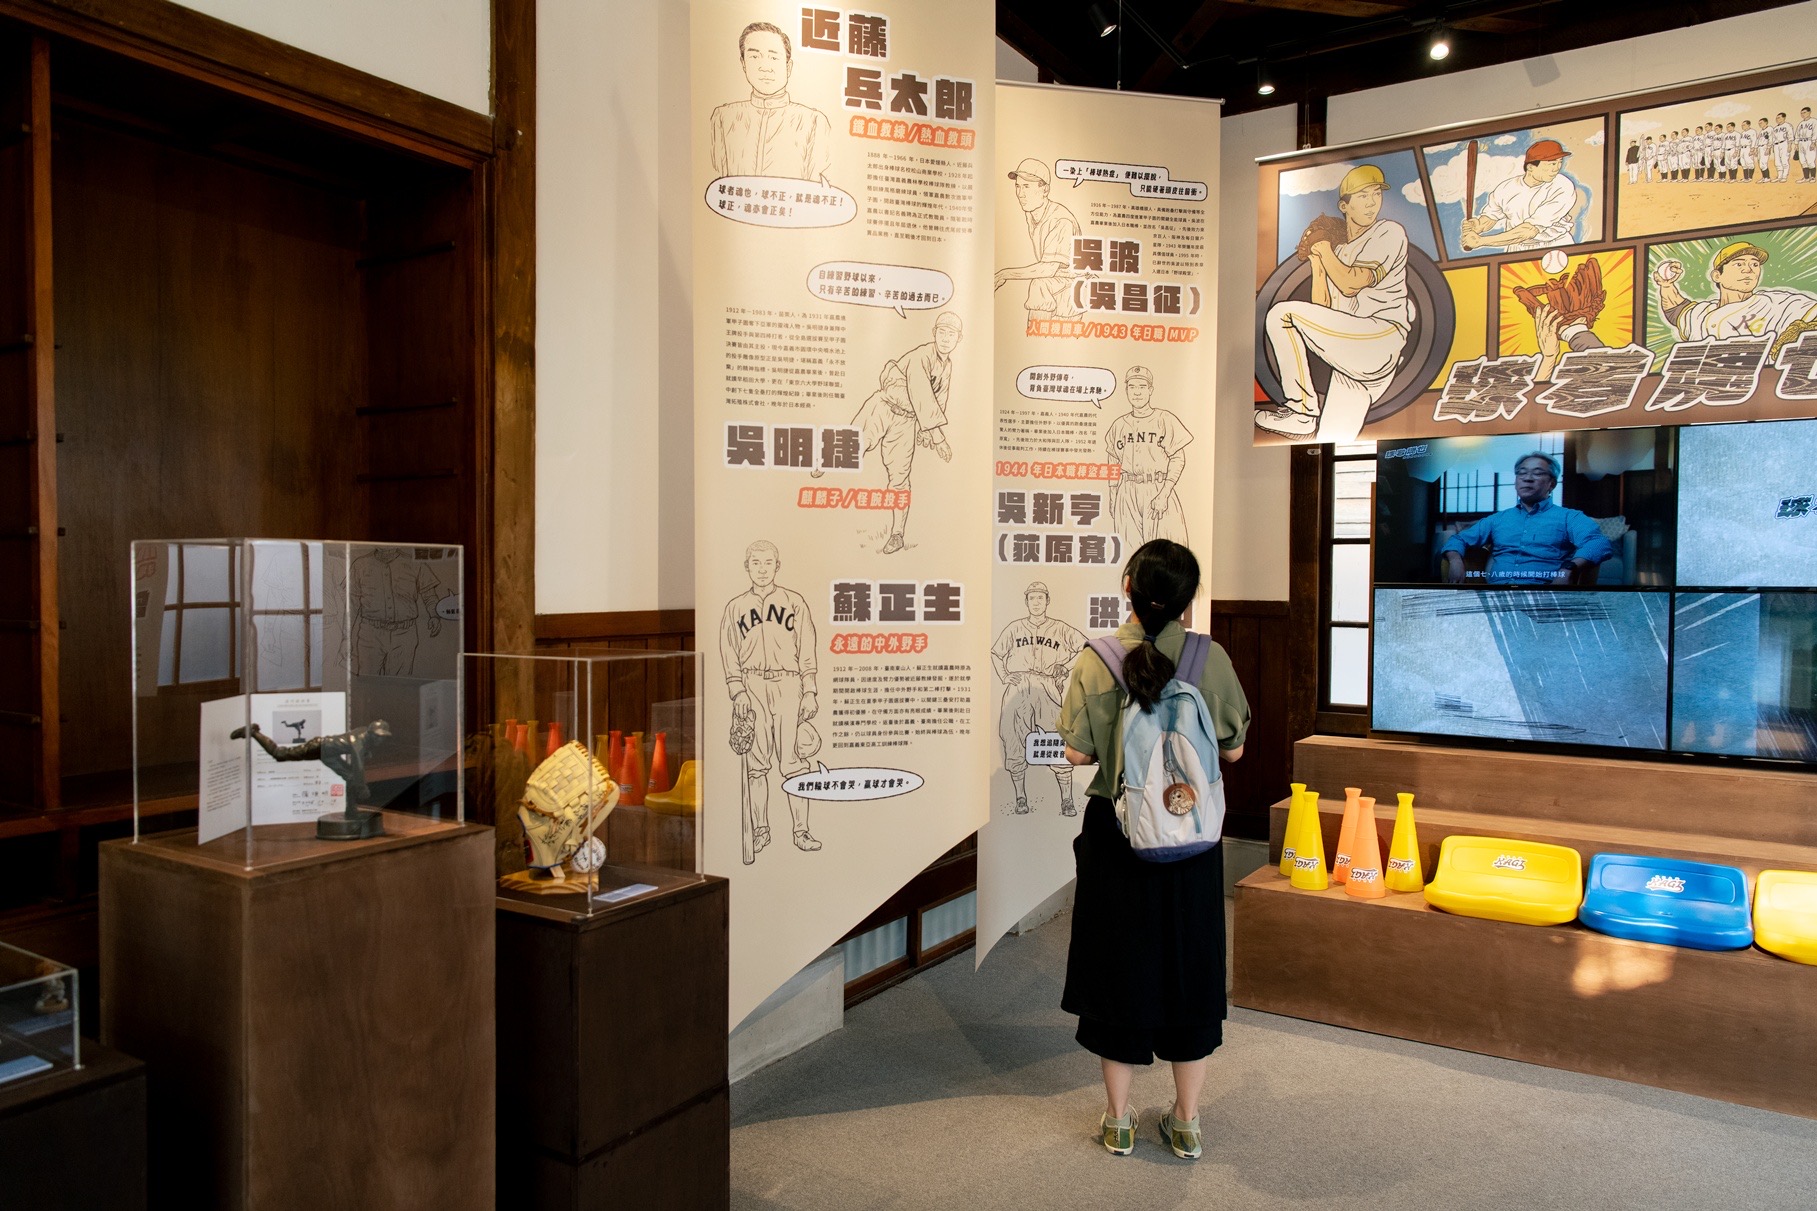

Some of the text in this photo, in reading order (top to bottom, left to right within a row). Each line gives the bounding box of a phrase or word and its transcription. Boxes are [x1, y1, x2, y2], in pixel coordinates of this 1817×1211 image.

[801, 8, 887, 58] 近藤
[844, 66, 973, 121] 兵太郎
[1073, 239, 1140, 274] 吳波
[818, 269, 882, 284] 自練習野球以來，
[818, 284, 946, 303] 只有辛苦的練習、辛苦的過去而已。
[1132, 323, 1164, 340] 年日職
[1169, 327, 1198, 342] MVP
[727, 425, 861, 469] 吳明捷
[996, 462, 1120, 480] 1944 年日本職棒盜壘王
[997, 492, 1101, 526] 吳新亨
[833, 582, 961, 622] 蘇正生
[833, 635, 926, 652] 永遠的中外野手
[1016, 636, 1061, 650] TAIWAN
[797, 778, 910, 792] 我們輸球不會哭，贏球才會哭。
